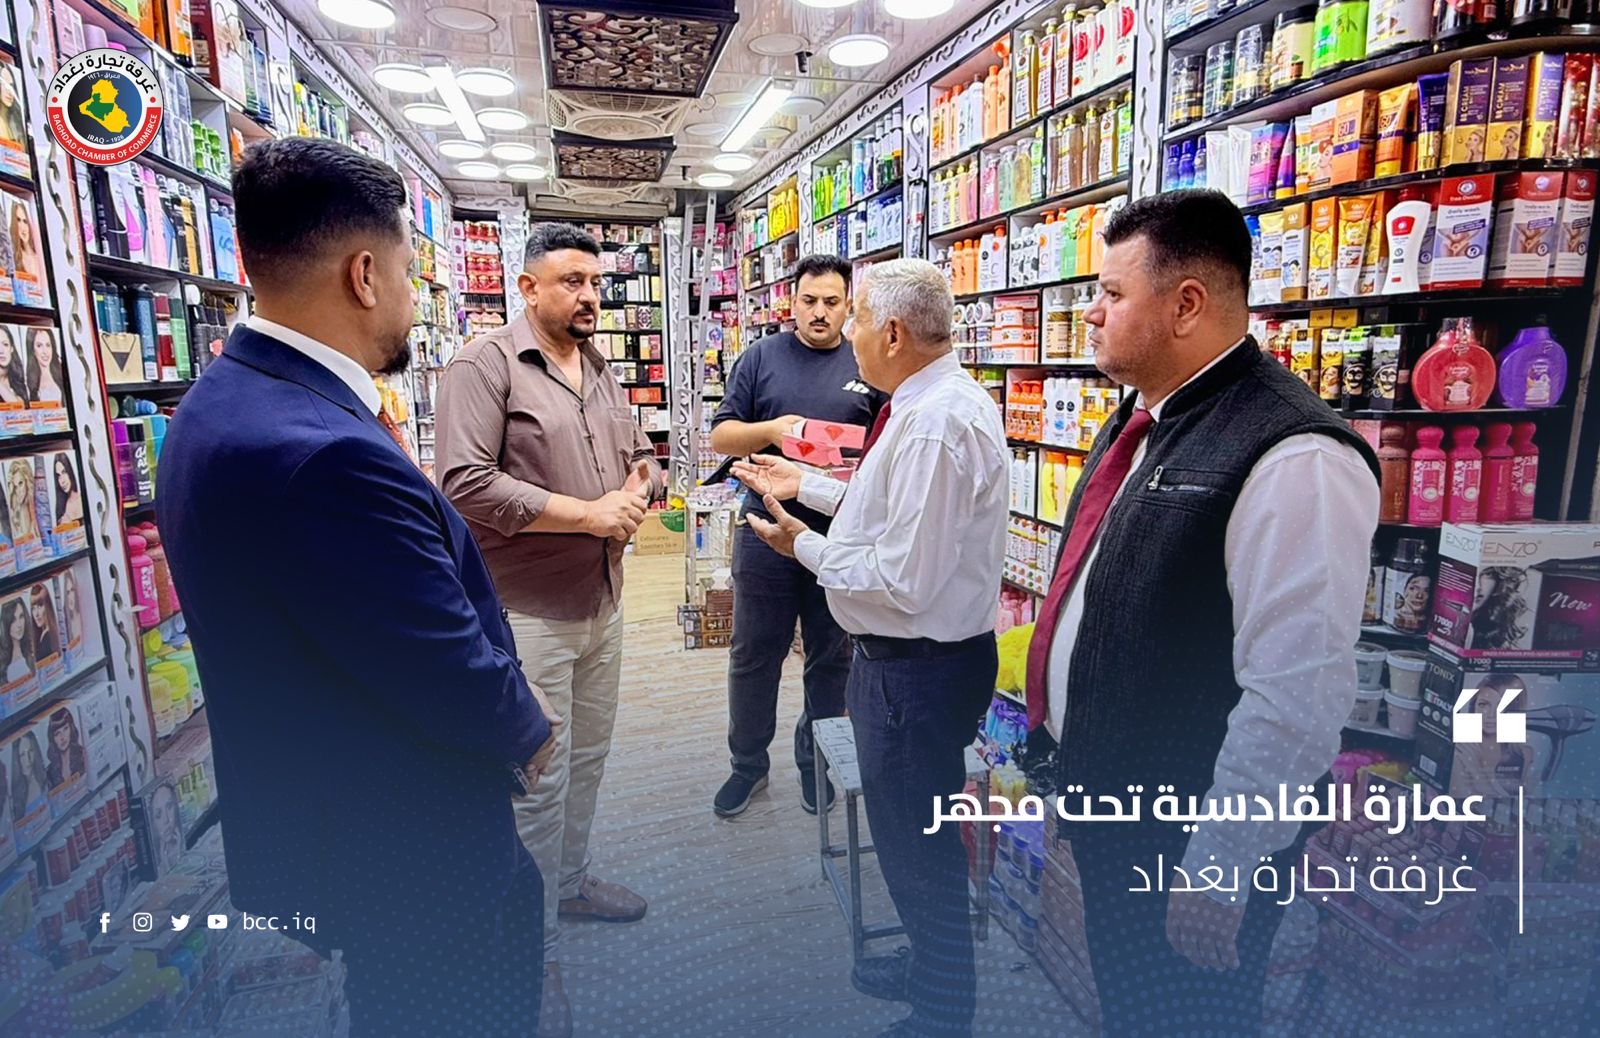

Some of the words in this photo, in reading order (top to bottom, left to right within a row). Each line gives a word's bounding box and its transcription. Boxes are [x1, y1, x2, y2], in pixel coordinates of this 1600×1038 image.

[1445, 532, 1475, 552] ENZO
[1482, 542, 1538, 558] ENZO
[1549, 591, 1592, 611] New
[1429, 662, 1455, 682] TONIX
